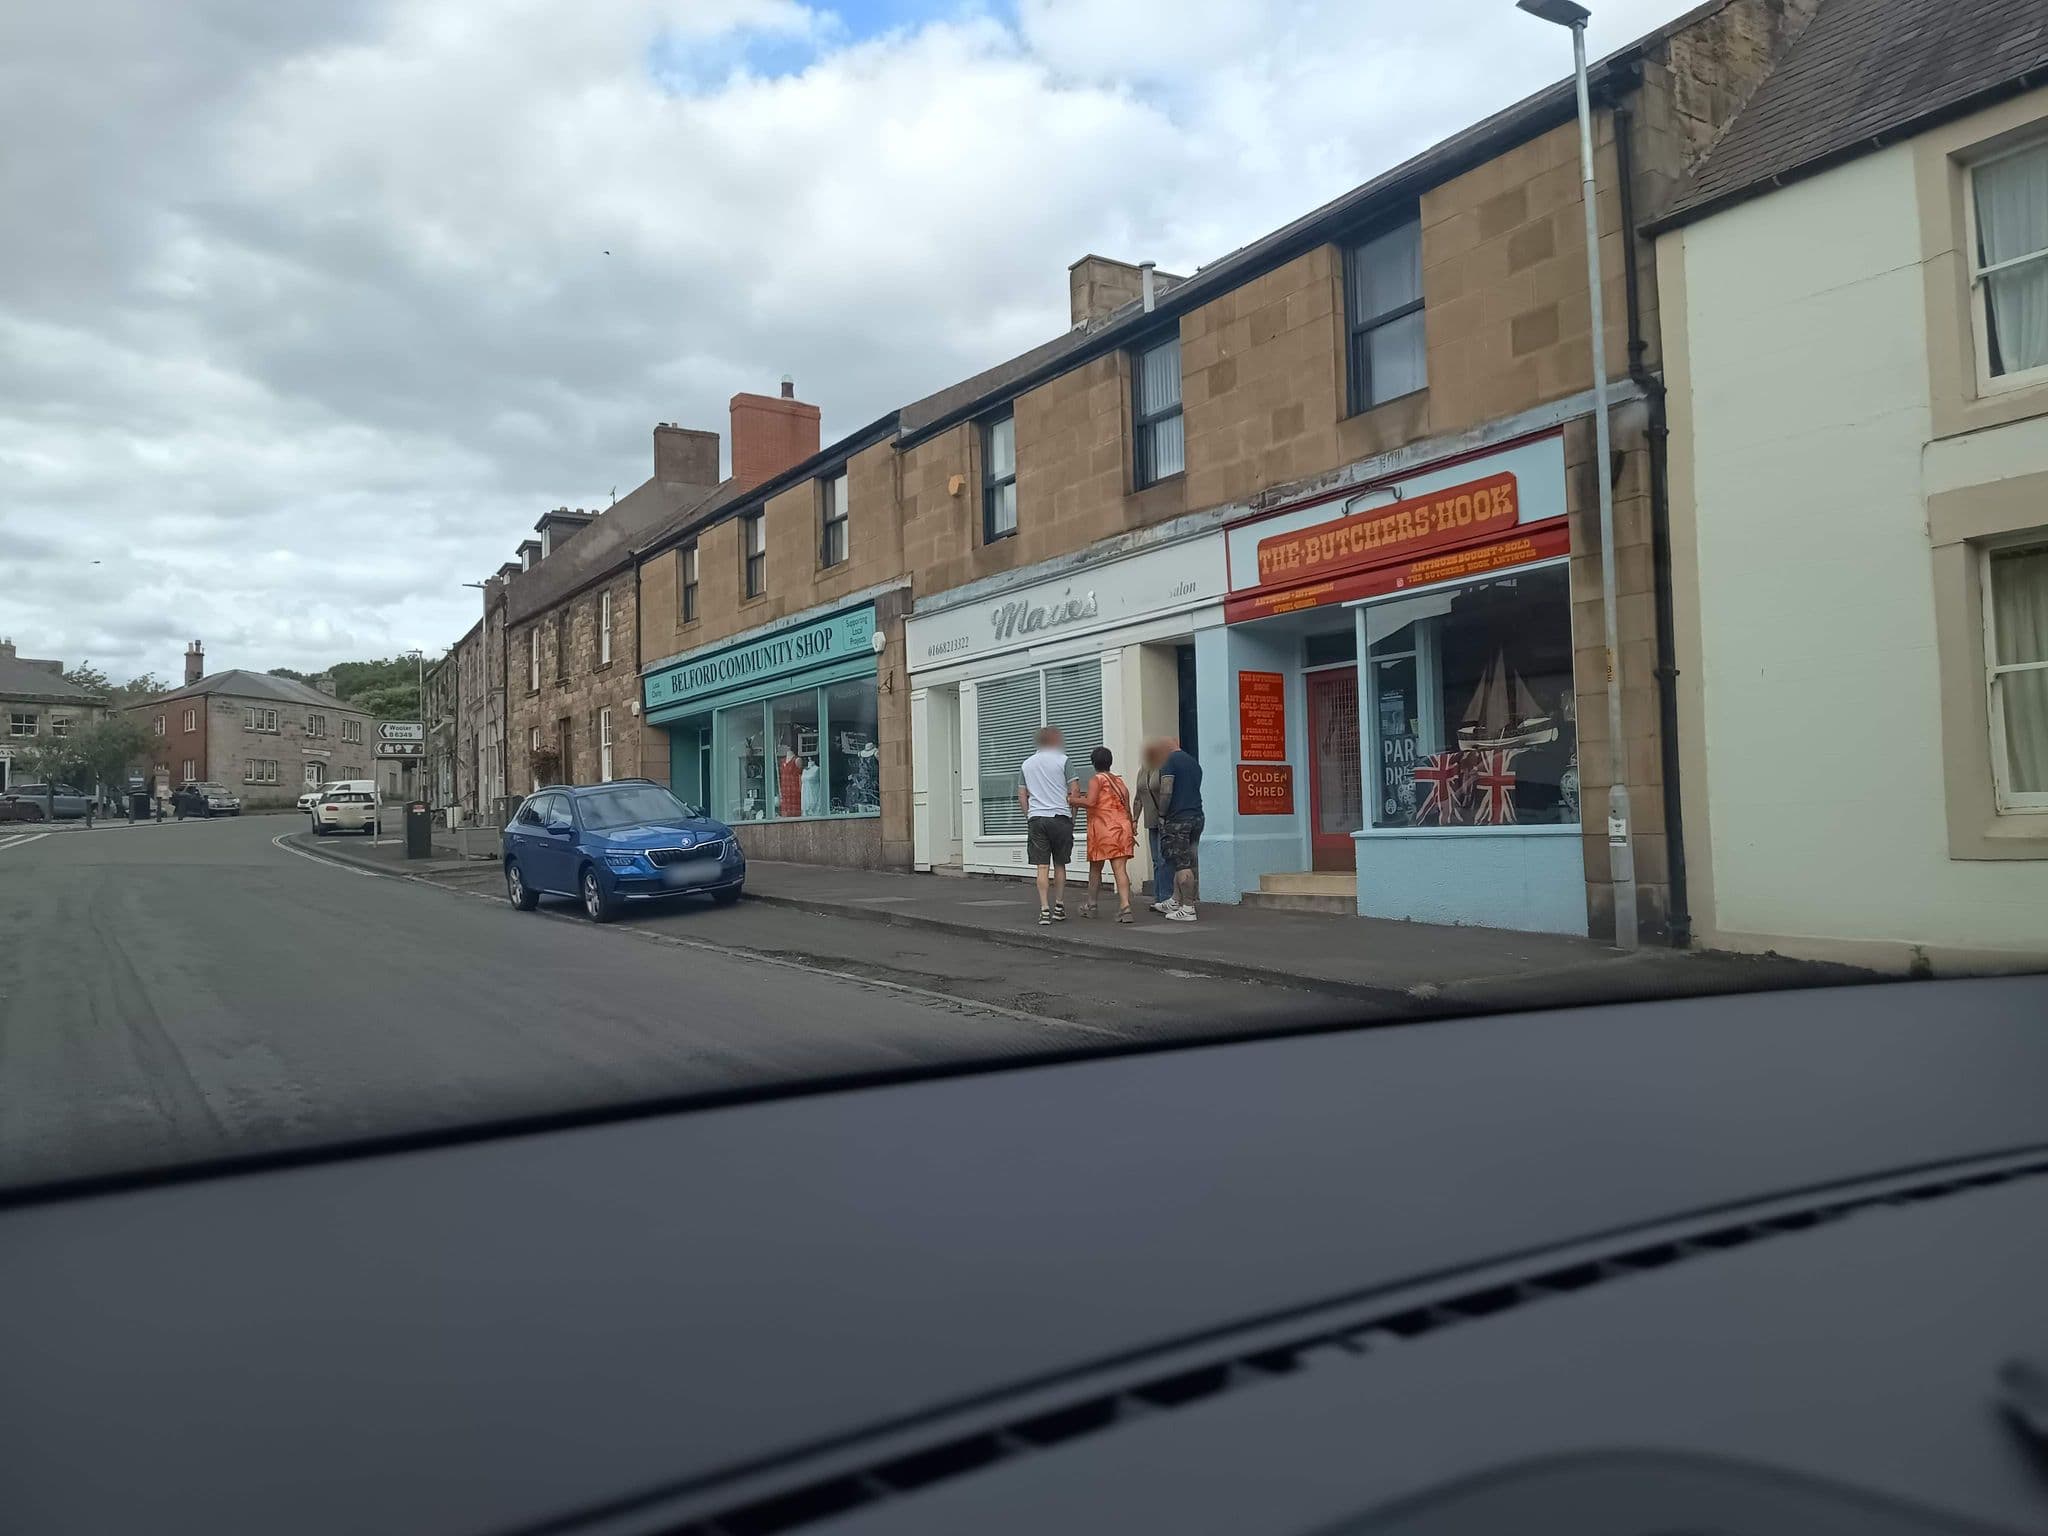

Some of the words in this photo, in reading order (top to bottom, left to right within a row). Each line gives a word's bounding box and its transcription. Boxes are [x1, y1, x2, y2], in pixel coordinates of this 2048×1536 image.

[1260, 541, 1301, 574] THE
[1305, 506, 1429, 565] BUTCHERS
[1436, 484, 1514, 532] HOOK
[1504, 539, 1530, 553] SOLD
[671, 662, 717, 695] BELFORD
[718, 638, 794, 681] COMMUNITY
[796, 627, 832, 659] SHOP
[1247, 783, 1285, 797] SHRED
